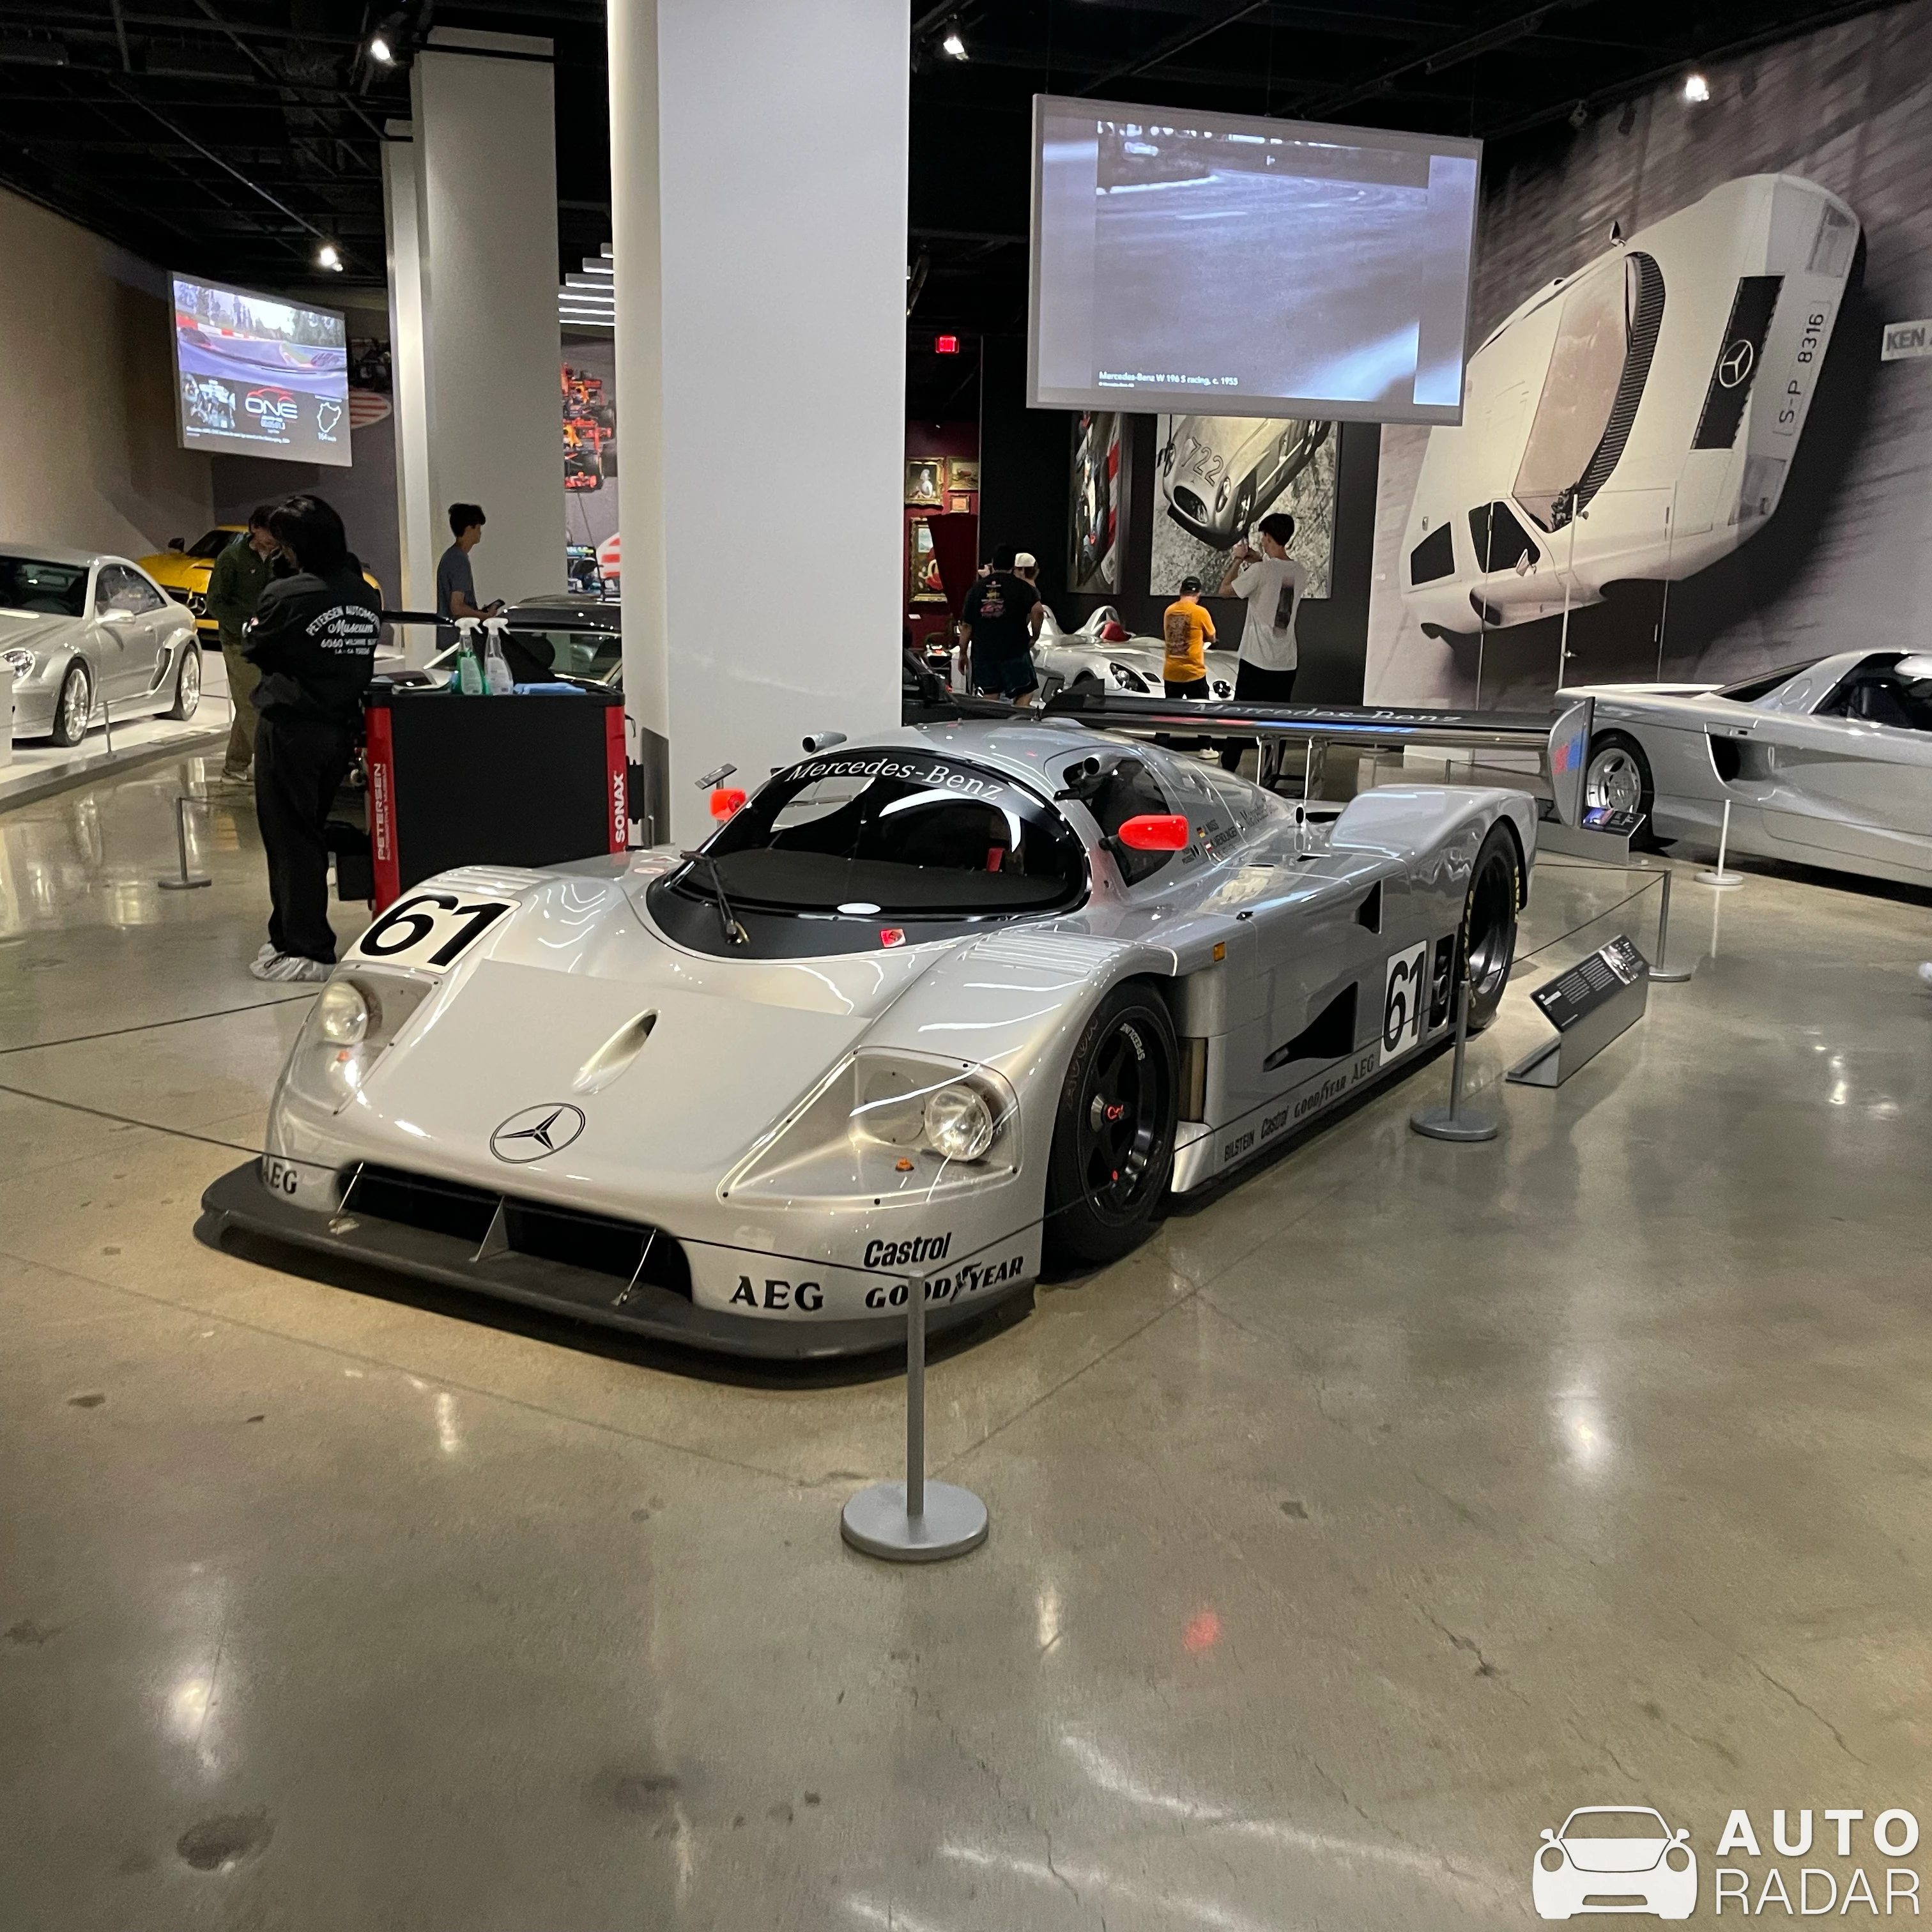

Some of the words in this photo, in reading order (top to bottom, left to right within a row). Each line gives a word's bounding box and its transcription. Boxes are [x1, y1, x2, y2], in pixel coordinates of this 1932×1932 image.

[1798, 313, 1824, 364] 8316
[1885, 327, 1926, 351] KEN
[1099, 371, 1155, 382] Mercedes-Benz
[1156, 374, 1165, 382] W
[1181, 374, 1186, 383] S
[245, 397, 298, 419] ONE
[1181, 436, 1224, 486] 722
[306, 606, 344, 636] PETERSEN
[328, 620, 374, 636] Museum
[321, 639, 344, 648] 6060
[785, 758, 1004, 801] Mercedes-Benz
[374, 763, 385, 860] PETERSEN
[613, 772, 625, 843] SONAX
[360, 894, 512, 967] 61
[1383, 951, 1425, 1052] 61
[1351, 1054, 1374, 1084] AEG
[864, 1232, 952, 1268] Castrol
[728, 1275, 824, 1312] AEG
